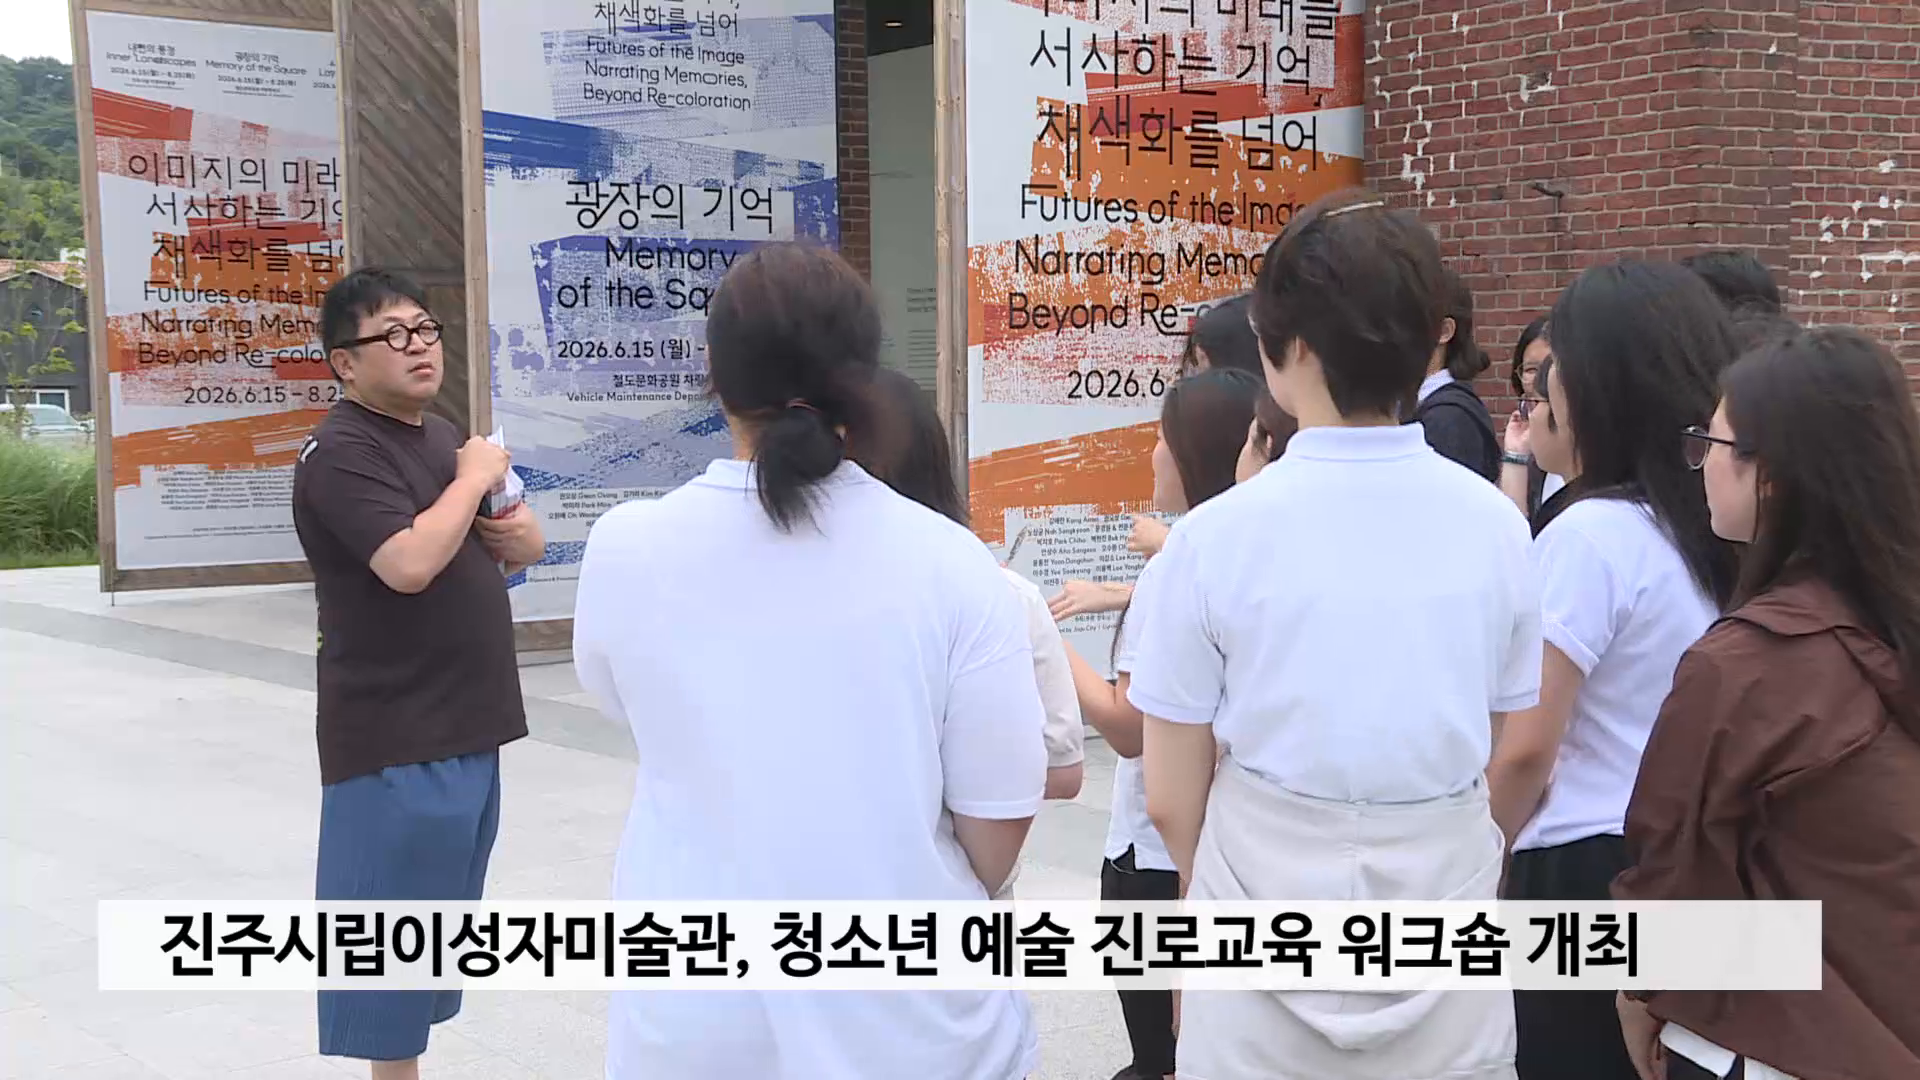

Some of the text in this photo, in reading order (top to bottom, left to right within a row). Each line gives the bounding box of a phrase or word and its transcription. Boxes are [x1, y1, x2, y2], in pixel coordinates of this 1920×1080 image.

[594, 0, 738, 38] 채색화를 넘어
[587, 35, 745, 67] Futures of the Image
[1030, 27, 1323, 107] 서사하는 기억,
[205, 60, 308, 75] Memory of the Square
[585, 59, 748, 89] Narrating Memories,
[583, 84, 751, 112] Beyond Re-coloration
[1036, 93, 1318, 181] 채색화를 넘어
[128, 152, 341, 193] 이미지의 미래
[146, 192, 286, 230] 서사하는
[565, 180, 774, 234] 광장의 기억
[1020, 184, 1137, 224] Futures
[1148, 189, 1181, 225] of
[1189, 192, 1235, 226] the
[153, 229, 345, 279] 채색화를 넘
[1015, 234, 1166, 285] Narrating
[143, 281, 230, 305] Futures
[236, 284, 261, 305] of
[269, 285, 303, 307] the
[557, 277, 715, 317] of the Sq
[141, 309, 322, 339] Narrating Mem
[1008, 292, 1128, 336] Beyond
[138, 342, 324, 368] Beyond Re-colo
[557, 341, 654, 359] 2026.6.15
[660, 338, 691, 360] (월)
[184, 385, 287, 405] 2026.6.15
[567, 391, 604, 402] Vehicle
[606, 391, 672, 402] Maintenance
[612, 373, 680, 389] 철도문화공원
[1067, 368, 1165, 399] 2026.6
